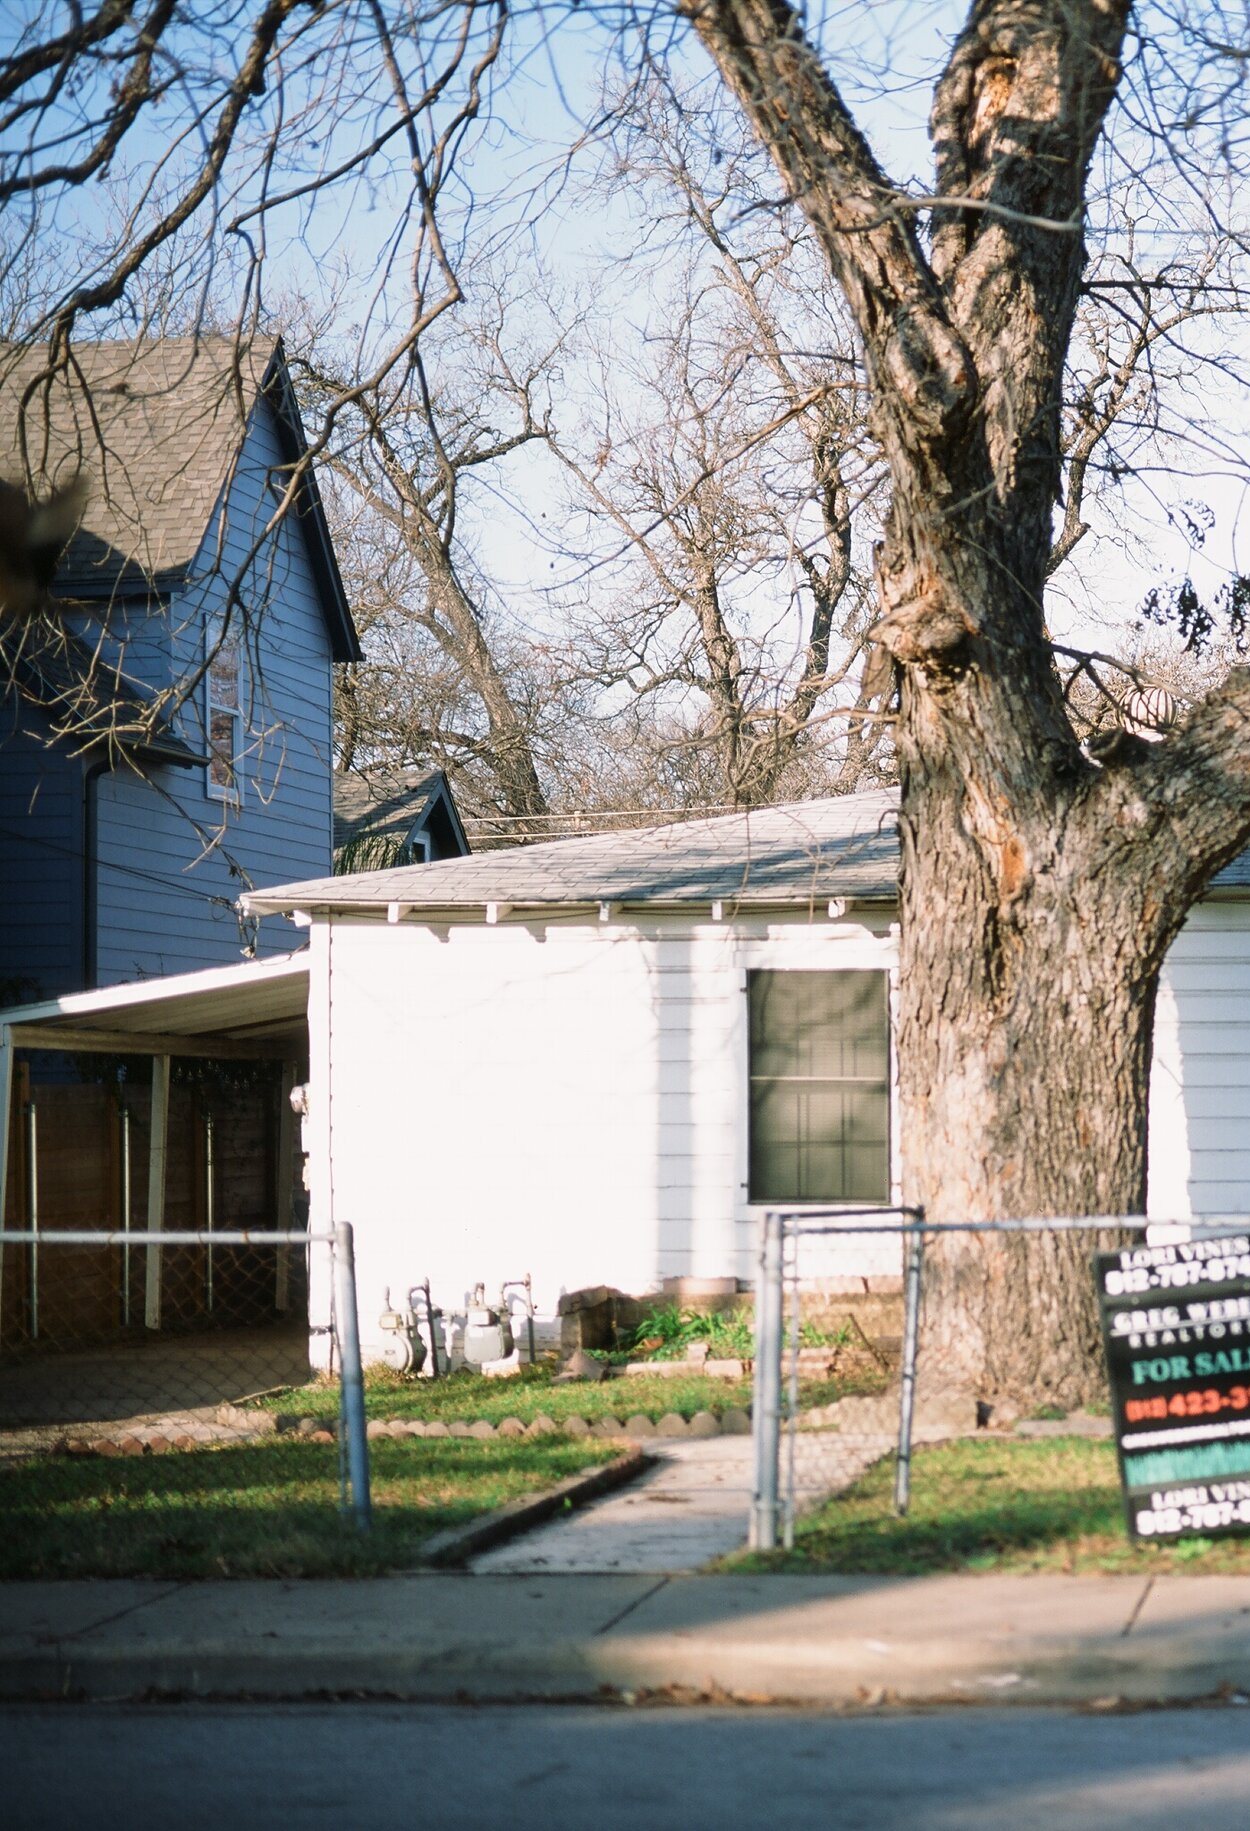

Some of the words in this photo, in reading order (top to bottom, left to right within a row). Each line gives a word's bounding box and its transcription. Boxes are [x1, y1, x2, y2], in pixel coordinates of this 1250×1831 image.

[1120, 1246, 1177, 1270] LORI
[1114, 1306, 1180, 1332] GREG
[1132, 1355, 1192, 1385] FOR
